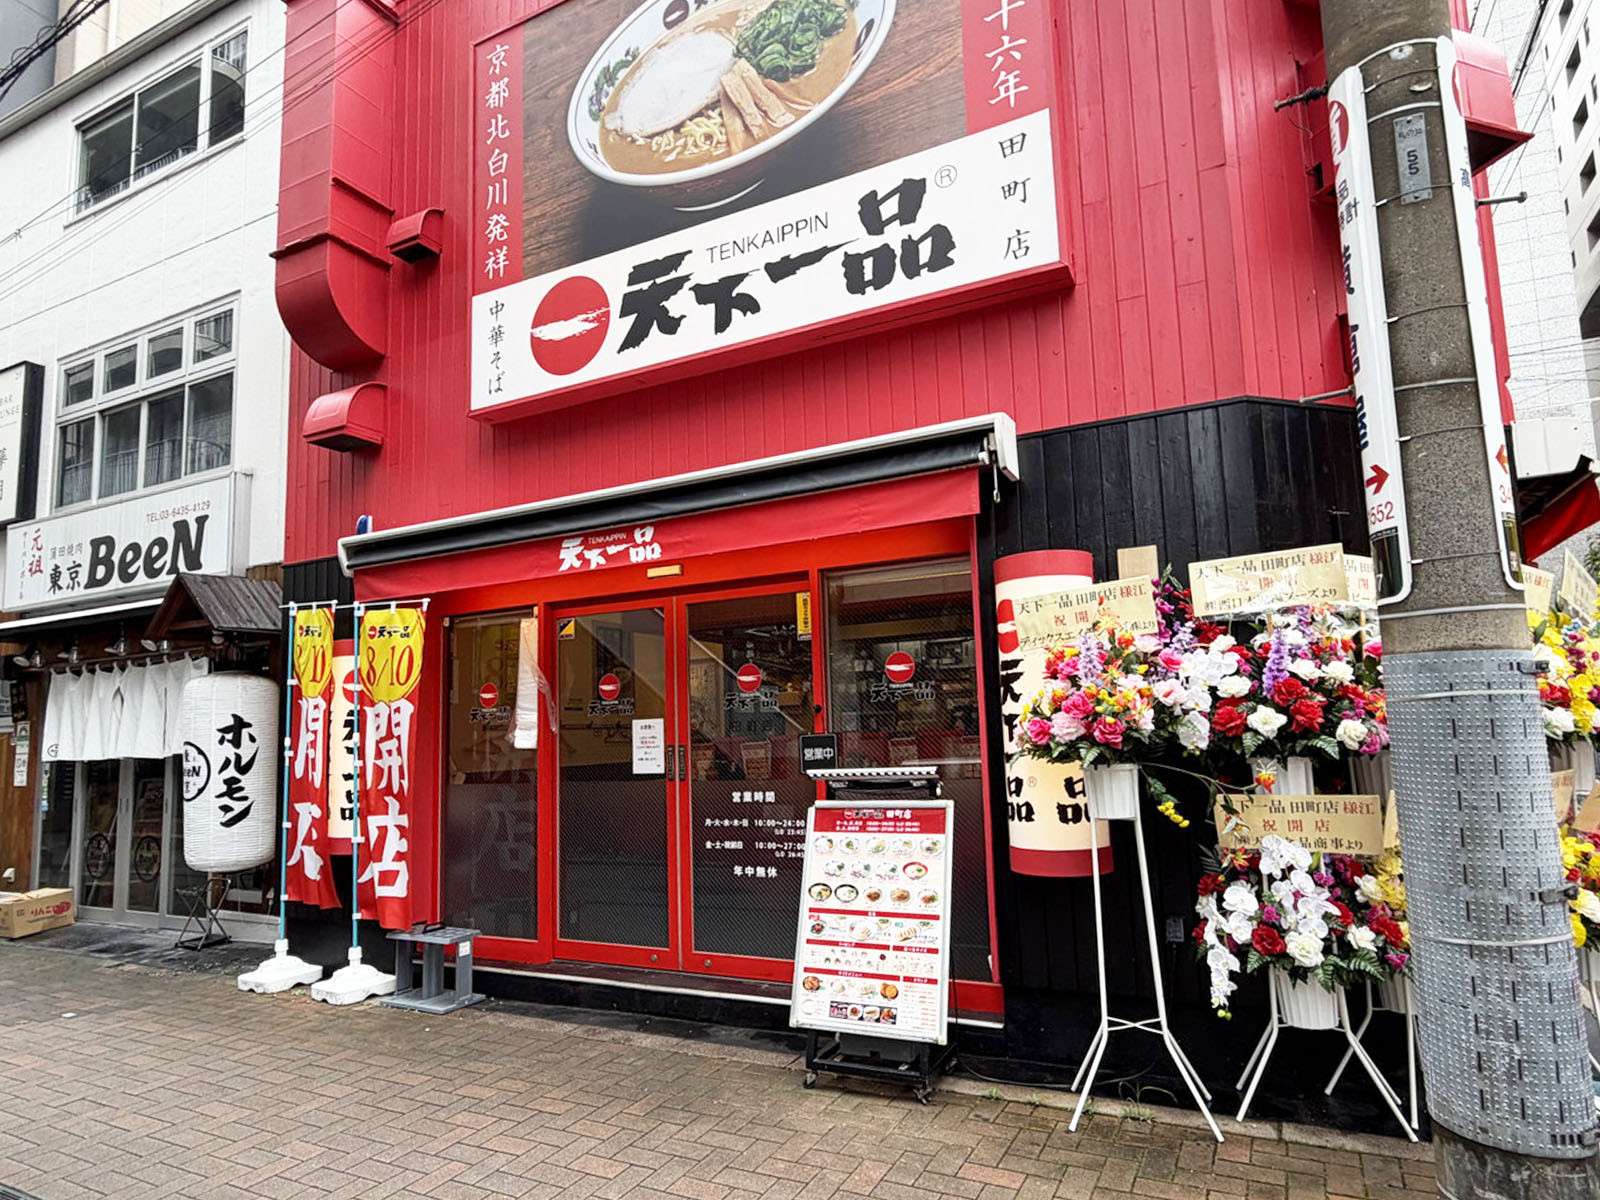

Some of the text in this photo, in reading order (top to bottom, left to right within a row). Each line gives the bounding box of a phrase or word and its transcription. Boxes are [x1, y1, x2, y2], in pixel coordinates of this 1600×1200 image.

[984, 0, 1030, 108] 十六年
[485, 44, 510, 280] 京都北白川発祥
[998, 132, 1032, 260] 田町店
[706, 212, 829, 264] TENKAIPPIN
[616, 178, 957, 355] 天下一品
[488, 300, 505, 394] 中華そば
[28, 528, 44, 577] 元祖
[84, 514, 209, 589] BeeN
[559, 526, 662, 572] 天下一品
[47, 560, 83, 595] 東京
[366, 645, 415, 687] 8/10
[215, 713, 259, 828] ホルモン
[804, 747, 834, 761] 営業中
[357, 698, 415, 899] 開店
[732, 791, 775, 803] 営業時間
[1263, 819, 1330, 832] 祝開店
[733, 865, 777, 878] 年中無休
